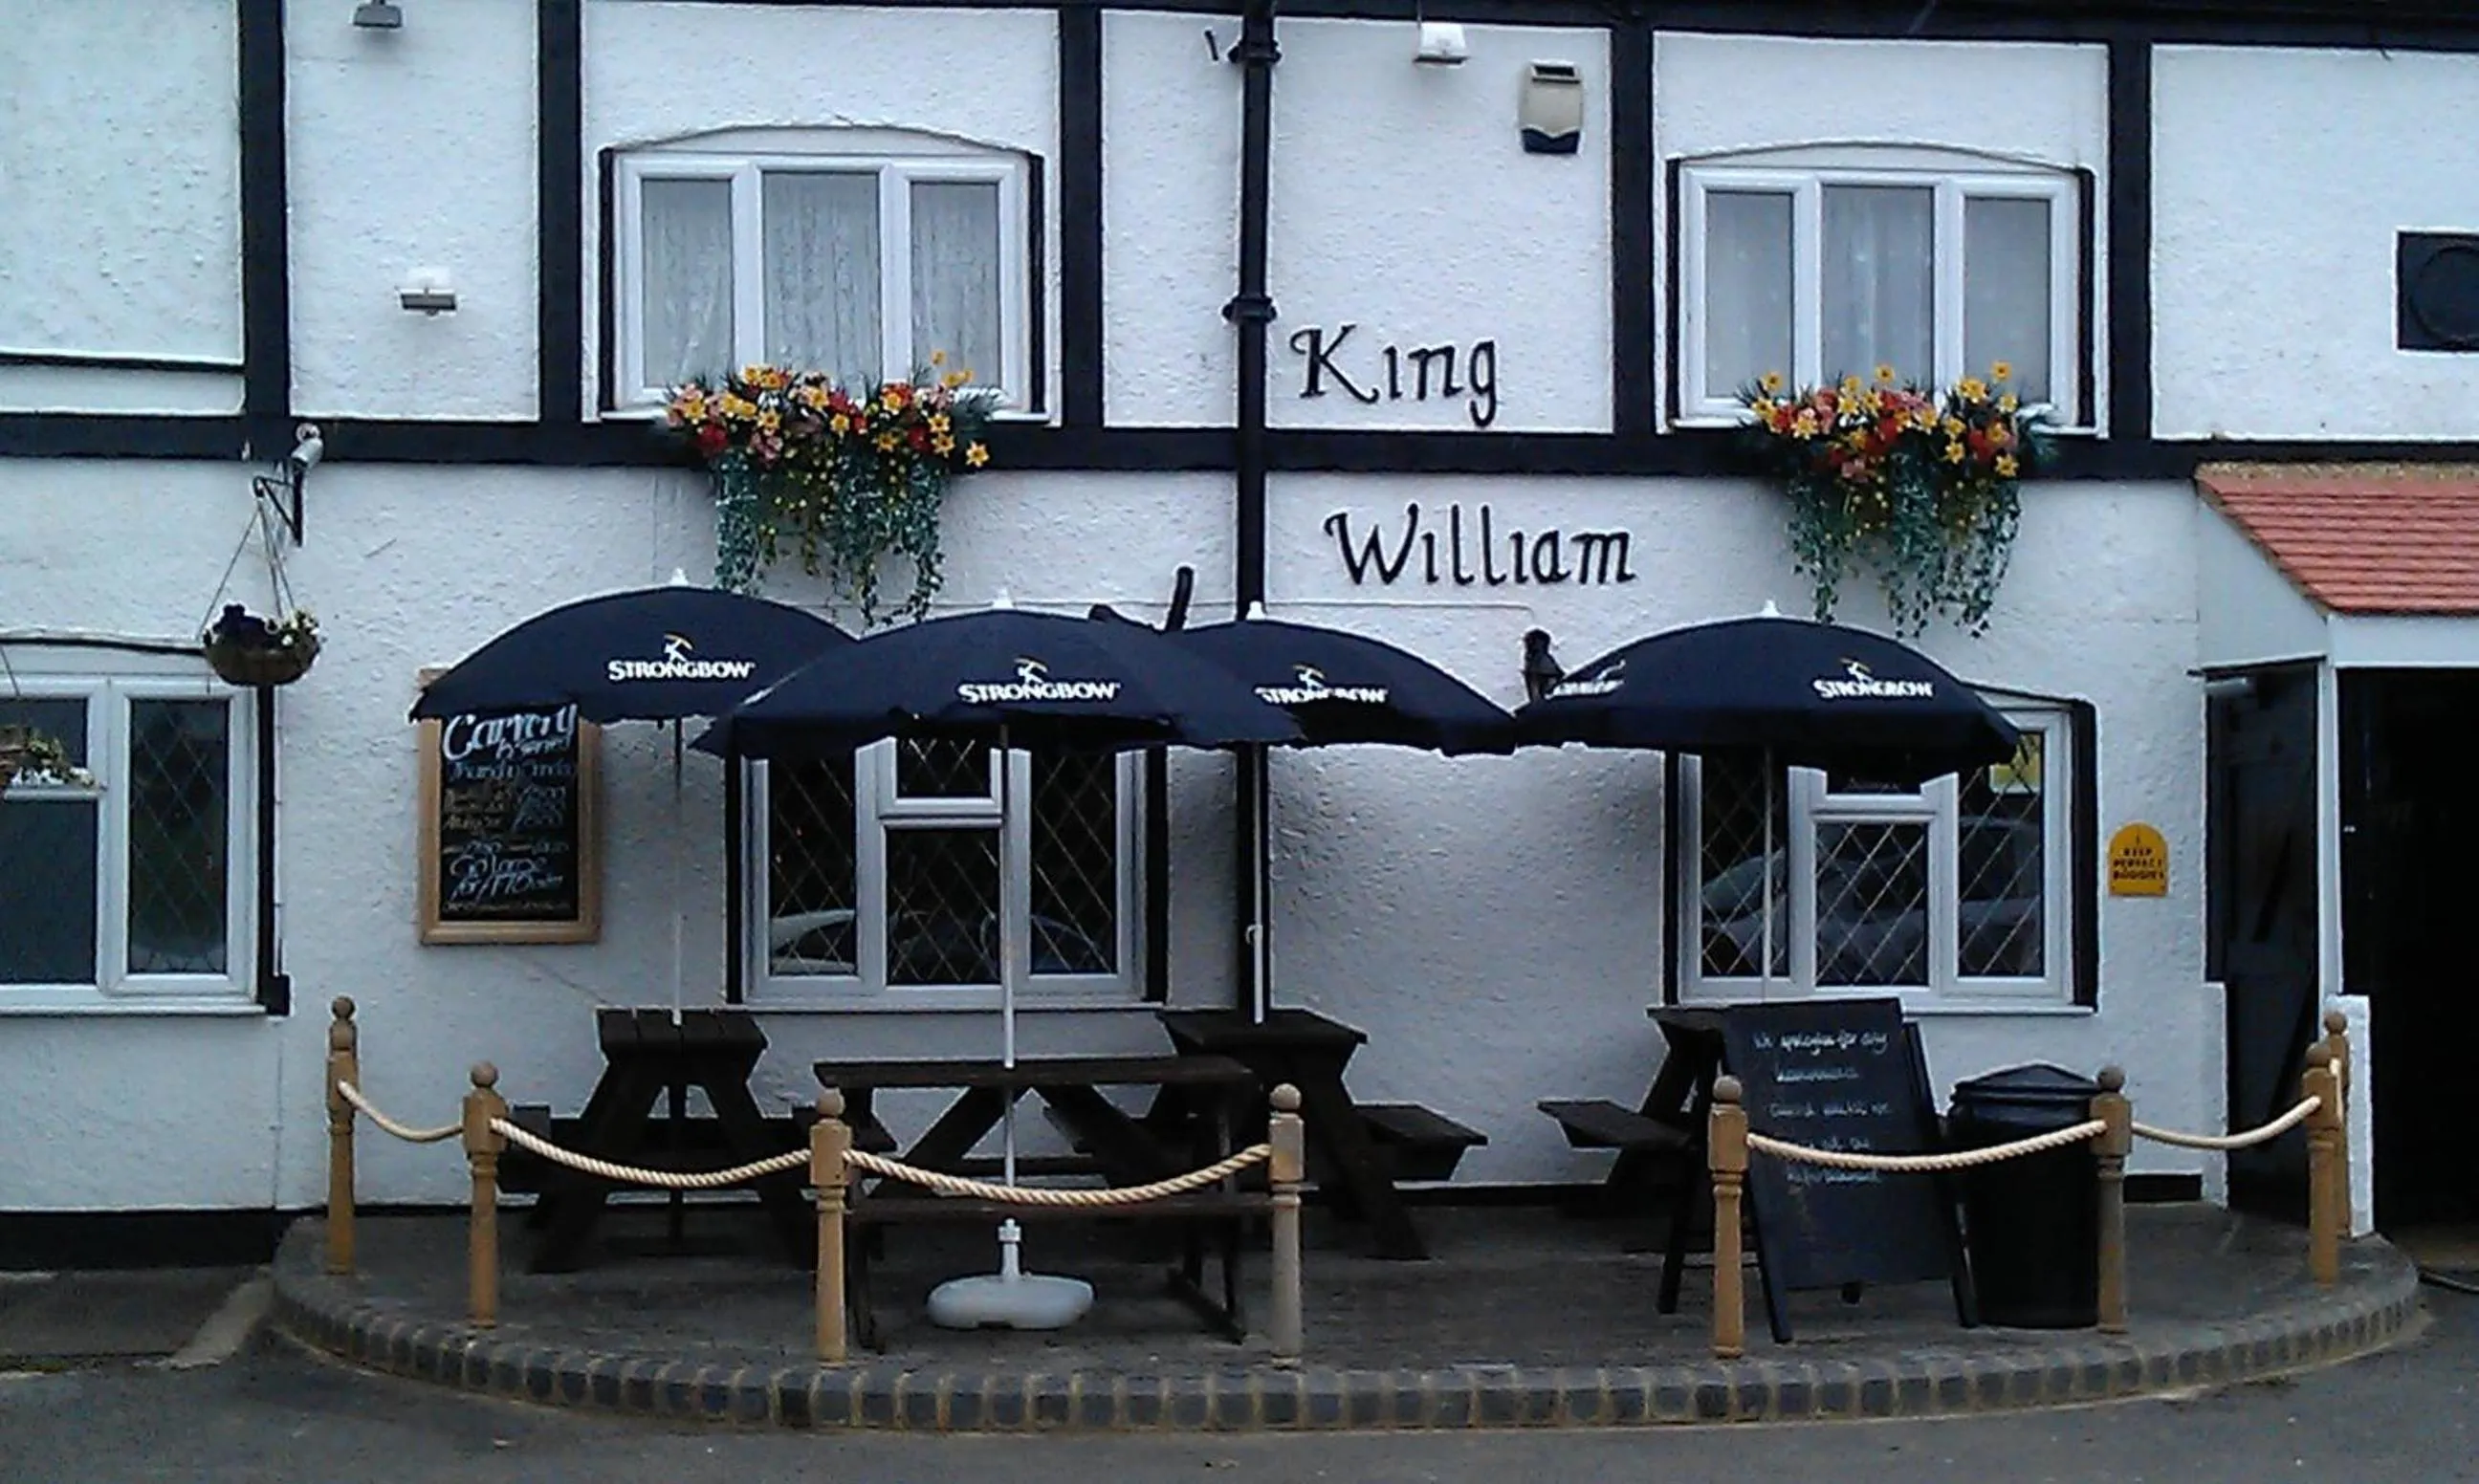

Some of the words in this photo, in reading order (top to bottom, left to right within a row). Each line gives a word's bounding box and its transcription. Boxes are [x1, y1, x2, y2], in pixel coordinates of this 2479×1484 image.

[1289, 324, 1497, 427] King
[1324, 503, 1636, 585] William
[608, 660, 752, 680] STRONGBOW
[957, 682, 1117, 703] STRONGBOW
[1813, 679, 1932, 698] STRONGBOW
